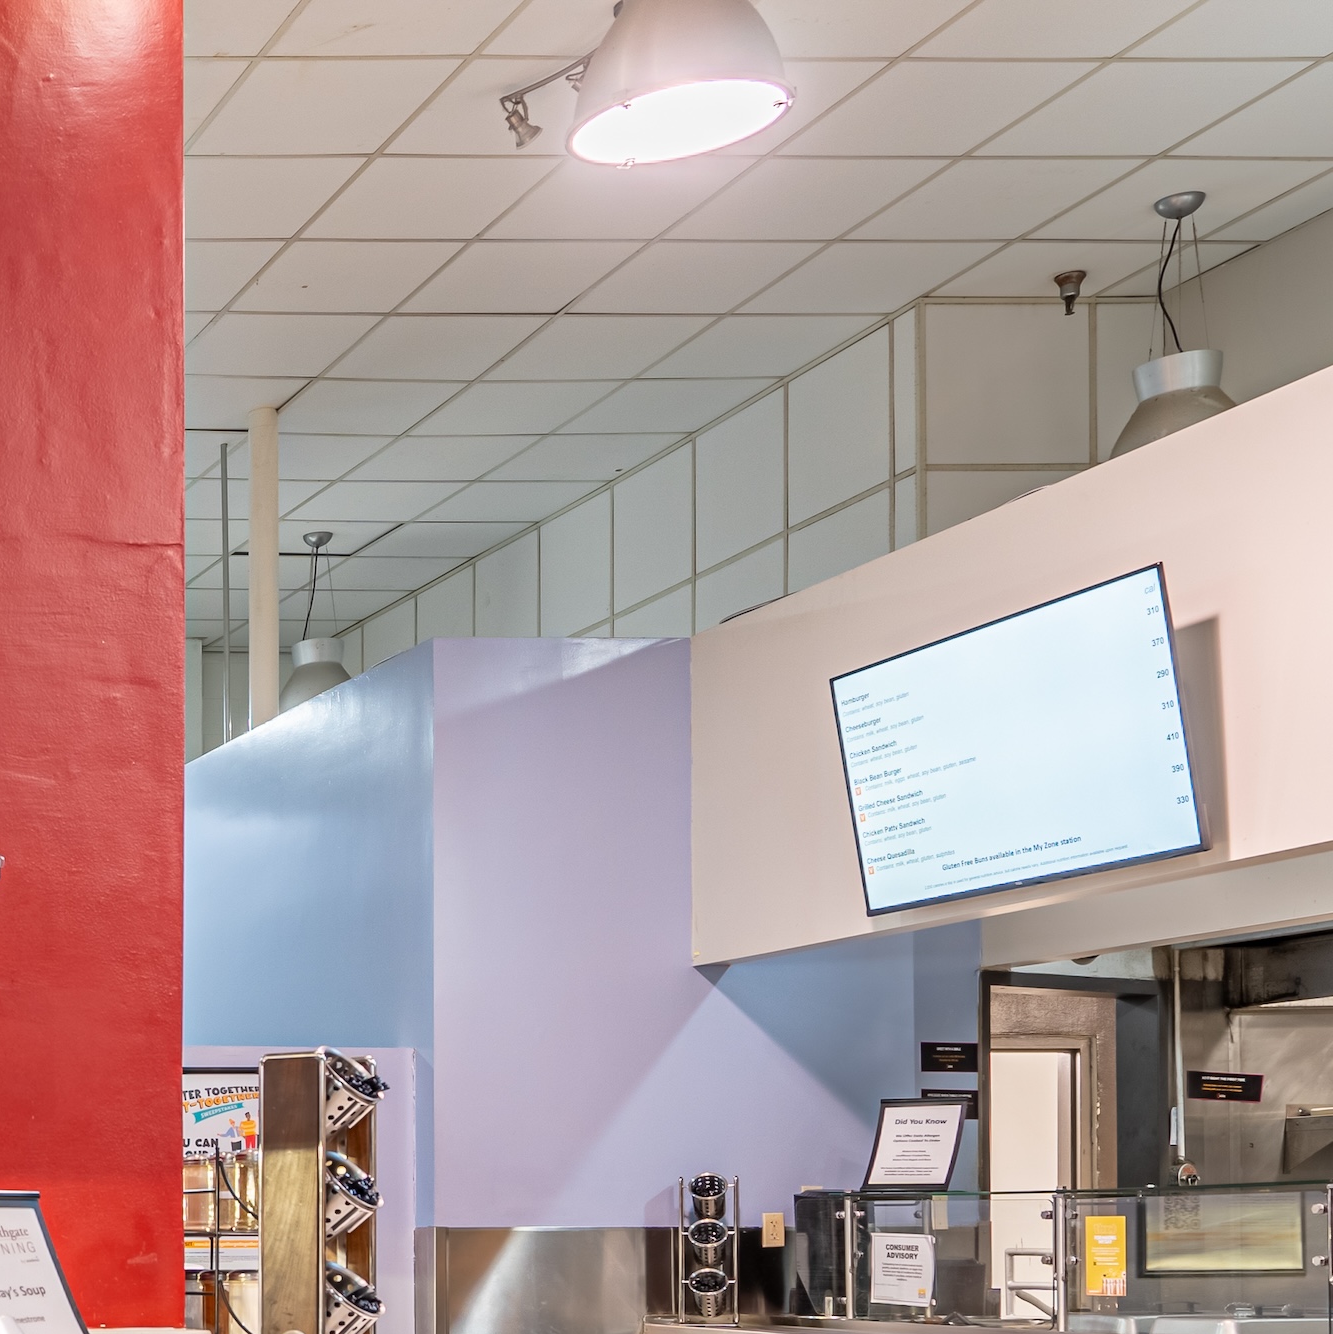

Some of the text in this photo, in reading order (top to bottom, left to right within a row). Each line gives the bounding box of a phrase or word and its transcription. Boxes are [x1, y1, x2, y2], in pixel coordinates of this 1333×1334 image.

[1144, 583, 1156, 595] cal
[1147, 605, 1159, 615] 310
[1152, 636, 1164, 647] 370
[1156, 668, 1169, 678] 290
[841, 692, 870, 706] Hamburger
[1161, 699, 1174, 710] 310
[845, 717, 881, 733] Cheeseburger
[1166, 731, 1179, 741] 410
[849, 740, 897, 759] Chicken Sandwich
[1172, 763, 1184, 773] 390
[854, 767, 902, 785] Black Bean Burger
[858, 790, 923, 812] Grilled Cheese Sandwich
[1177, 794, 1189, 805] 330
[862, 827, 883, 838] Chicken
[899, 818, 925, 829] Sandwich
[867, 848, 915, 864] Cheese Quesadilla
[942, 835, 1082, 871] Gluten Free Buns available in the My Zone station
[182, 1086, 259, 1101] TER TOGETHER
[182, 1092, 259, 1113] T-TOGETHER
[200, 1104, 238, 1119] SWEEPSTAKES
[195, 1138, 218, 1148] CAN
[19, 1286, 46, 1297] Soup
[14, 1315, 45, 1323] nestrone
